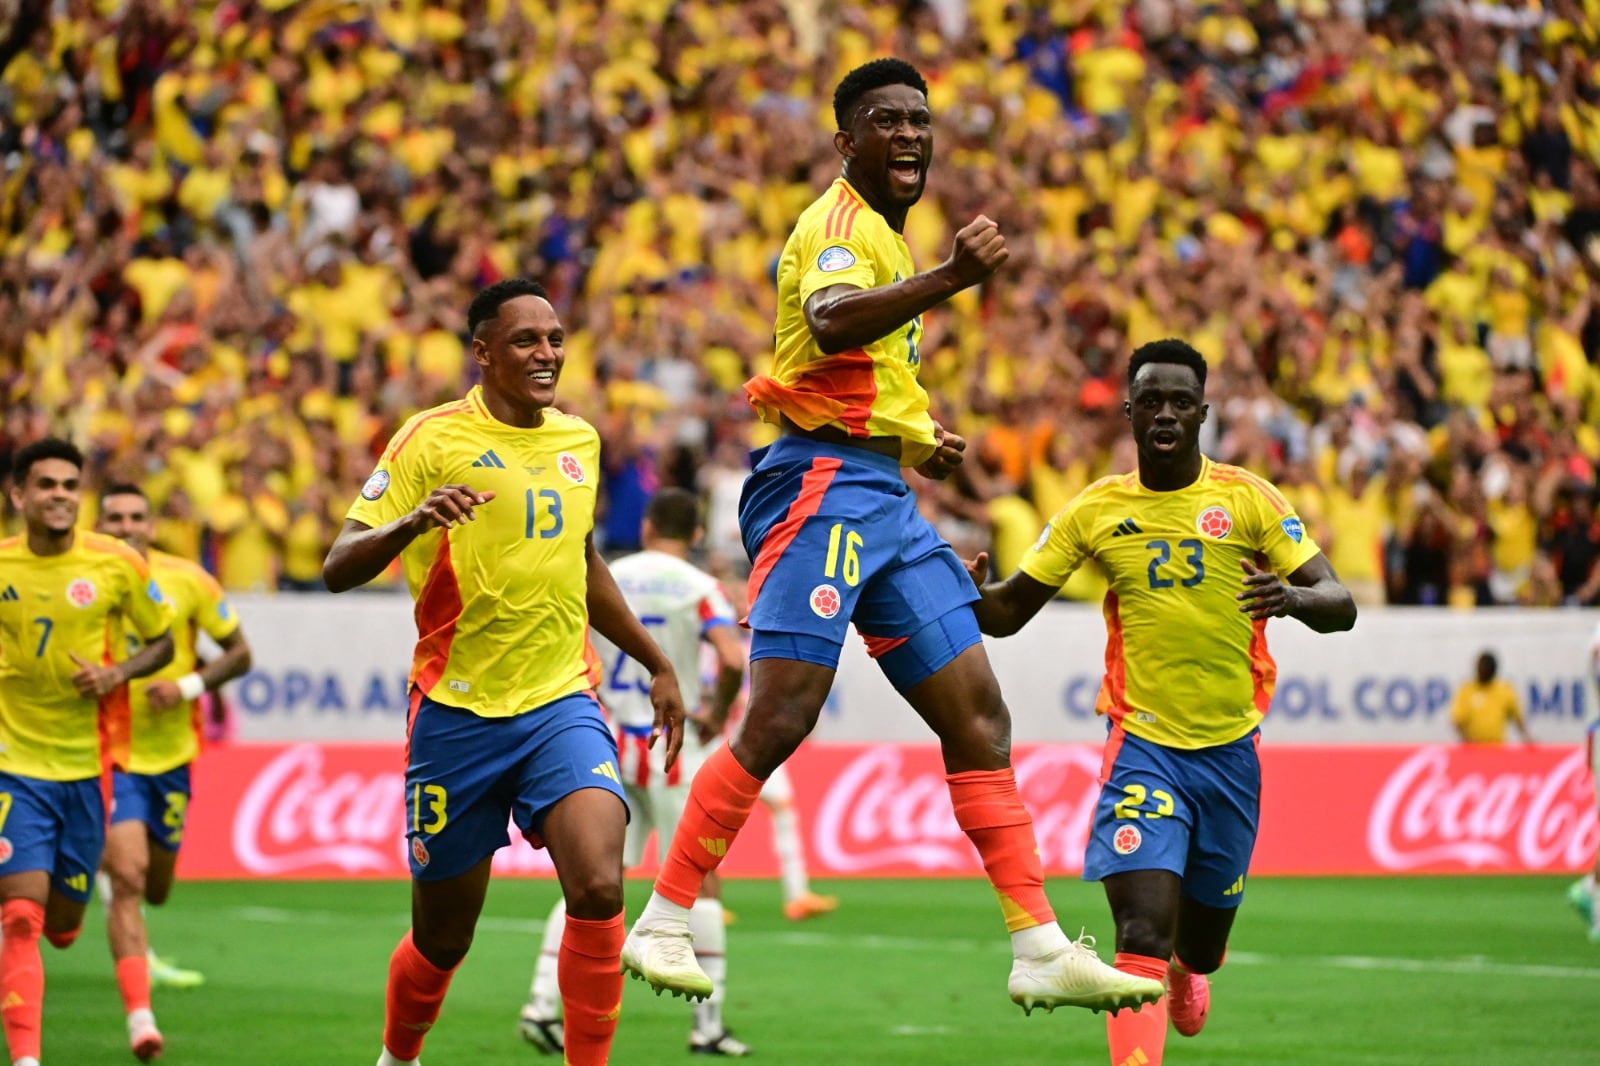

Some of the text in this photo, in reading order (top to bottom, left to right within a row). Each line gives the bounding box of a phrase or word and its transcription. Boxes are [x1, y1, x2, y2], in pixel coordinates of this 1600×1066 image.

[525, 488, 563, 539] 13
[824, 523, 864, 587] 16
[1146, 538, 1205, 589] 23
[33, 617, 53, 658] 7
[239, 669, 346, 715] OPA
[1353, 678, 1450, 721] COP
[413, 783, 448, 834] 13
